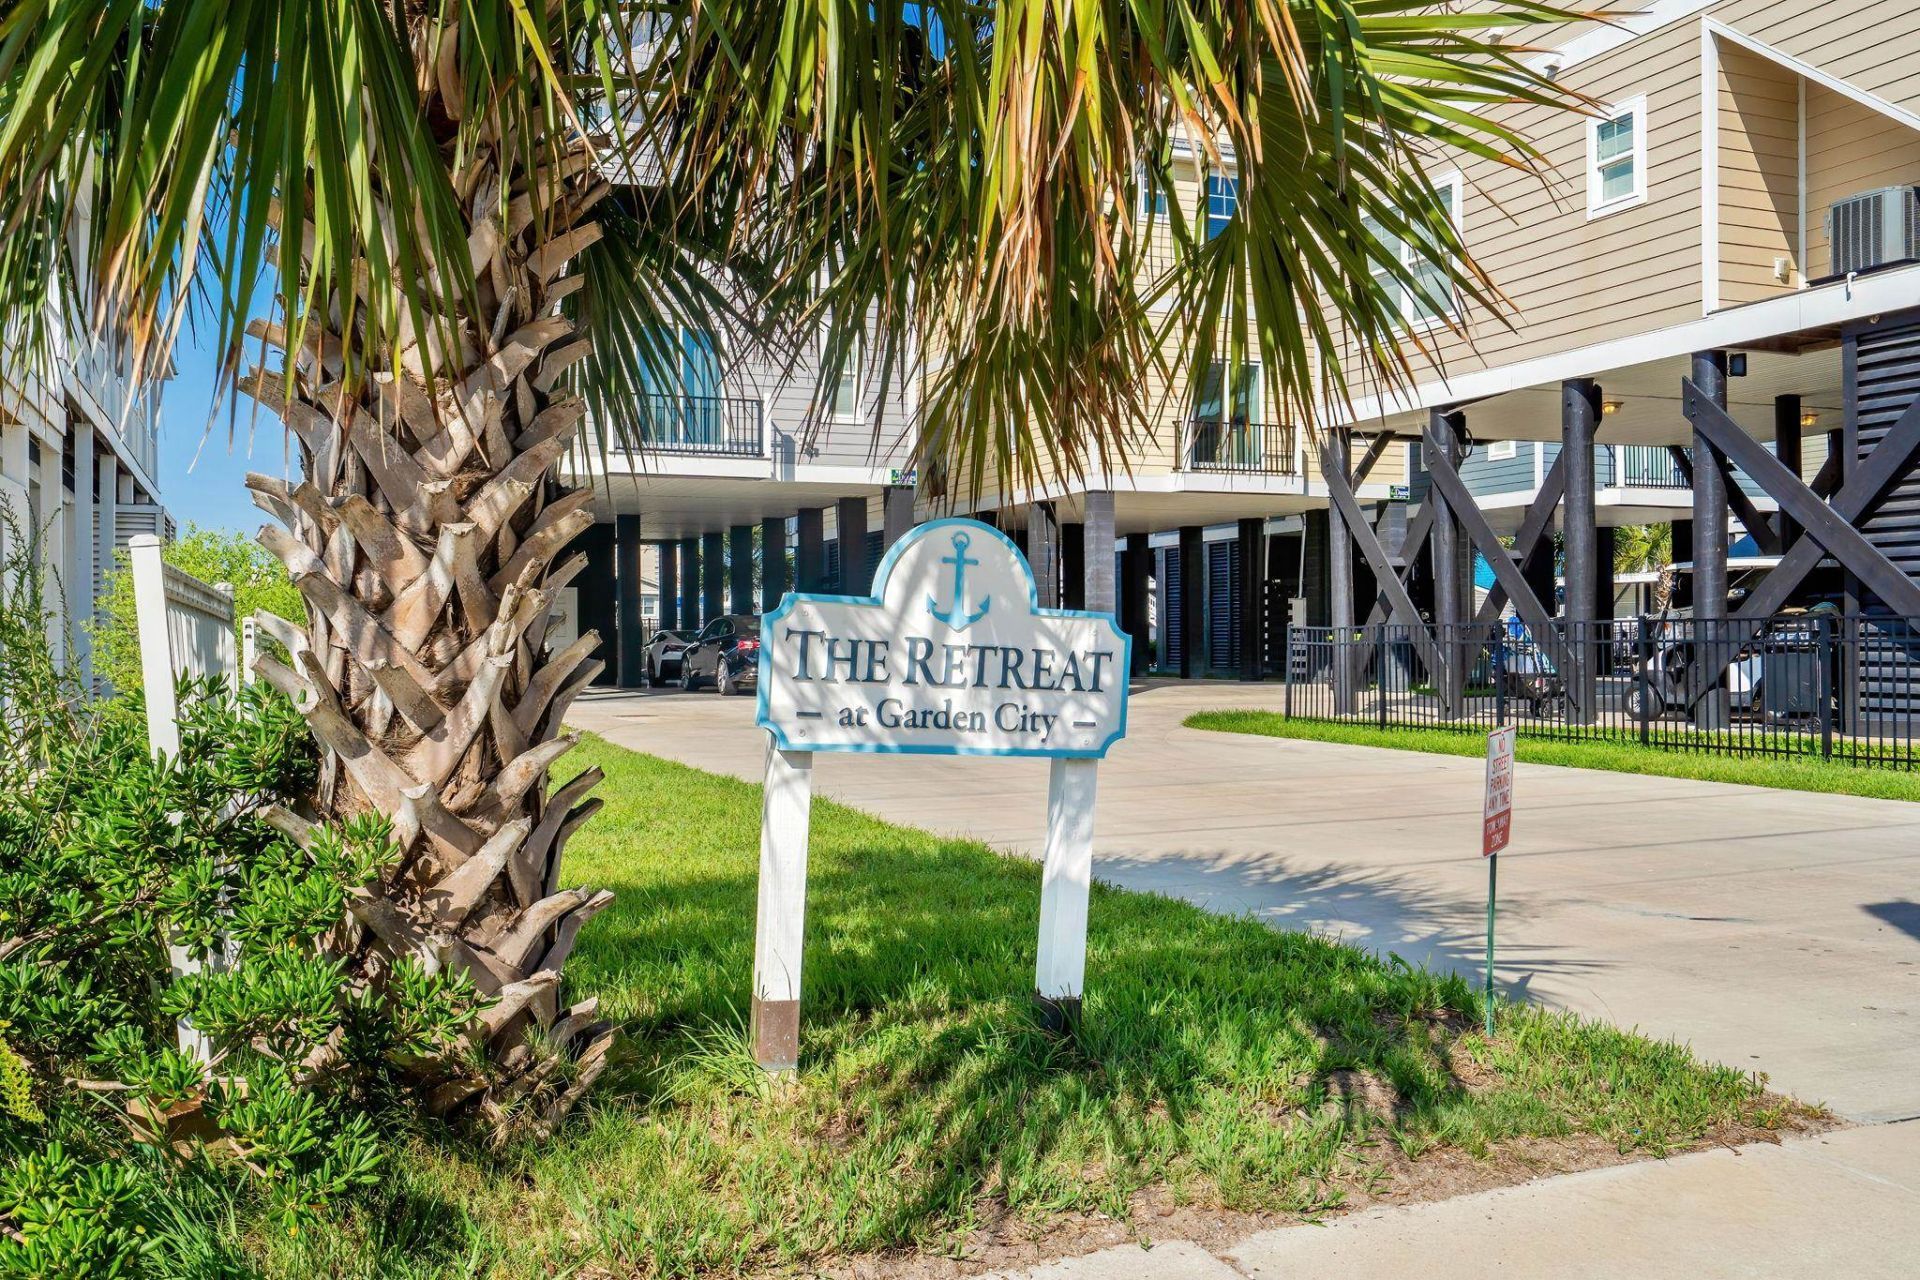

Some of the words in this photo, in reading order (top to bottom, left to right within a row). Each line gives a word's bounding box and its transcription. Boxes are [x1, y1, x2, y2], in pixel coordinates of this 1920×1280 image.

[786, 627, 890, 684] THE
[903, 636, 1112, 694] RETREAT
[838, 705, 869, 729] at
[876, 698, 986, 732] Garden
[994, 702, 1058, 743] City
